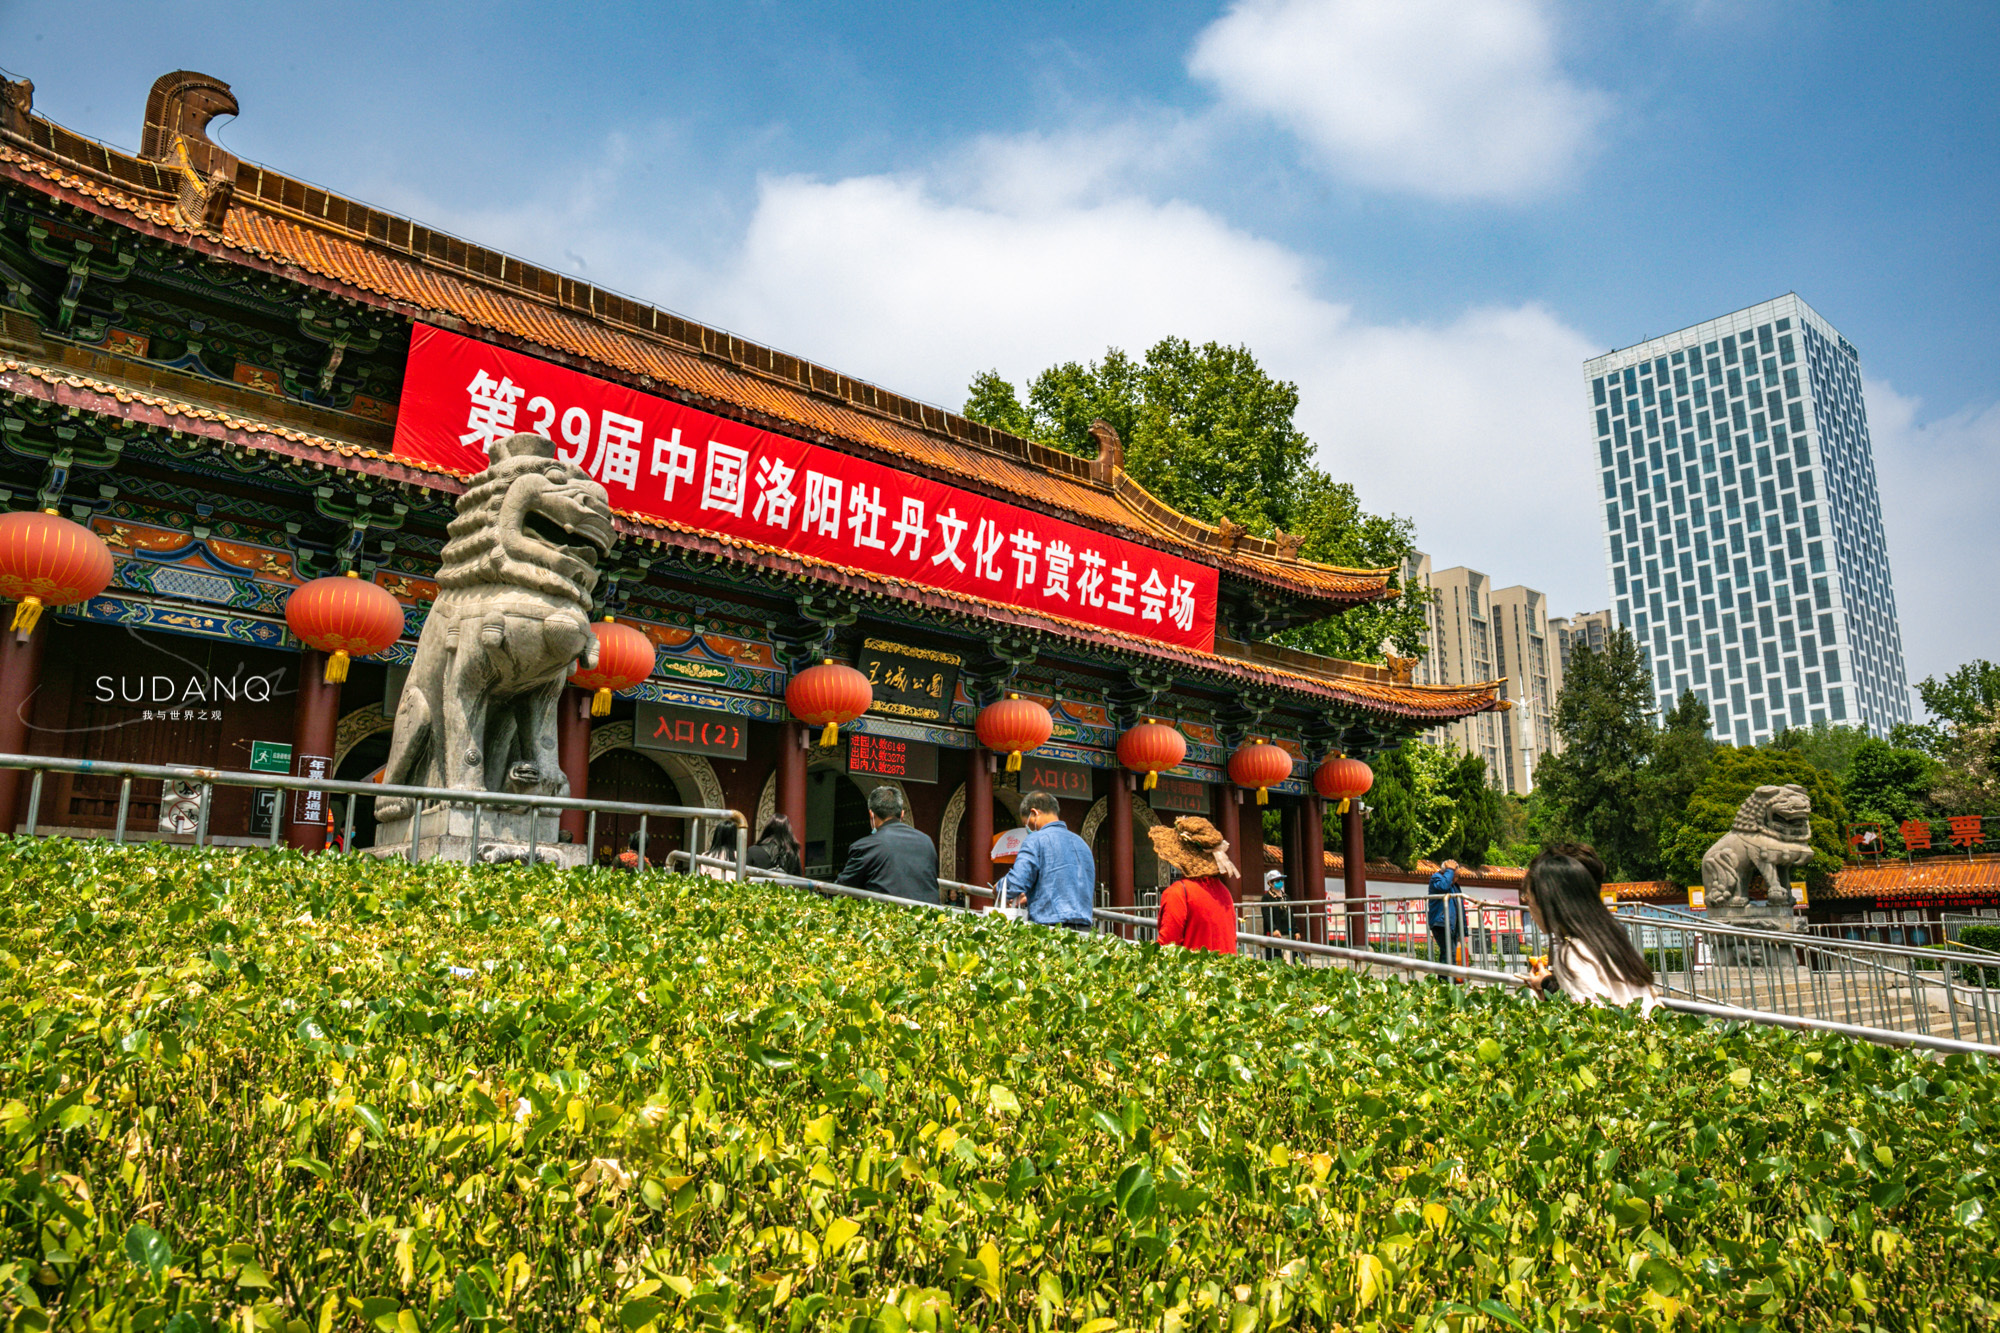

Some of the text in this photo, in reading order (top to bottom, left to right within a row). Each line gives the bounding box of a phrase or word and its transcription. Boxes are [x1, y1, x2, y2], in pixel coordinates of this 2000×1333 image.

[459, 369, 1196, 632] 第39届中国洛阳牡丹文化节赏花主会场
[304, 759, 326, 821] 年票用通道
[1899, 815, 1986, 851] 售票
